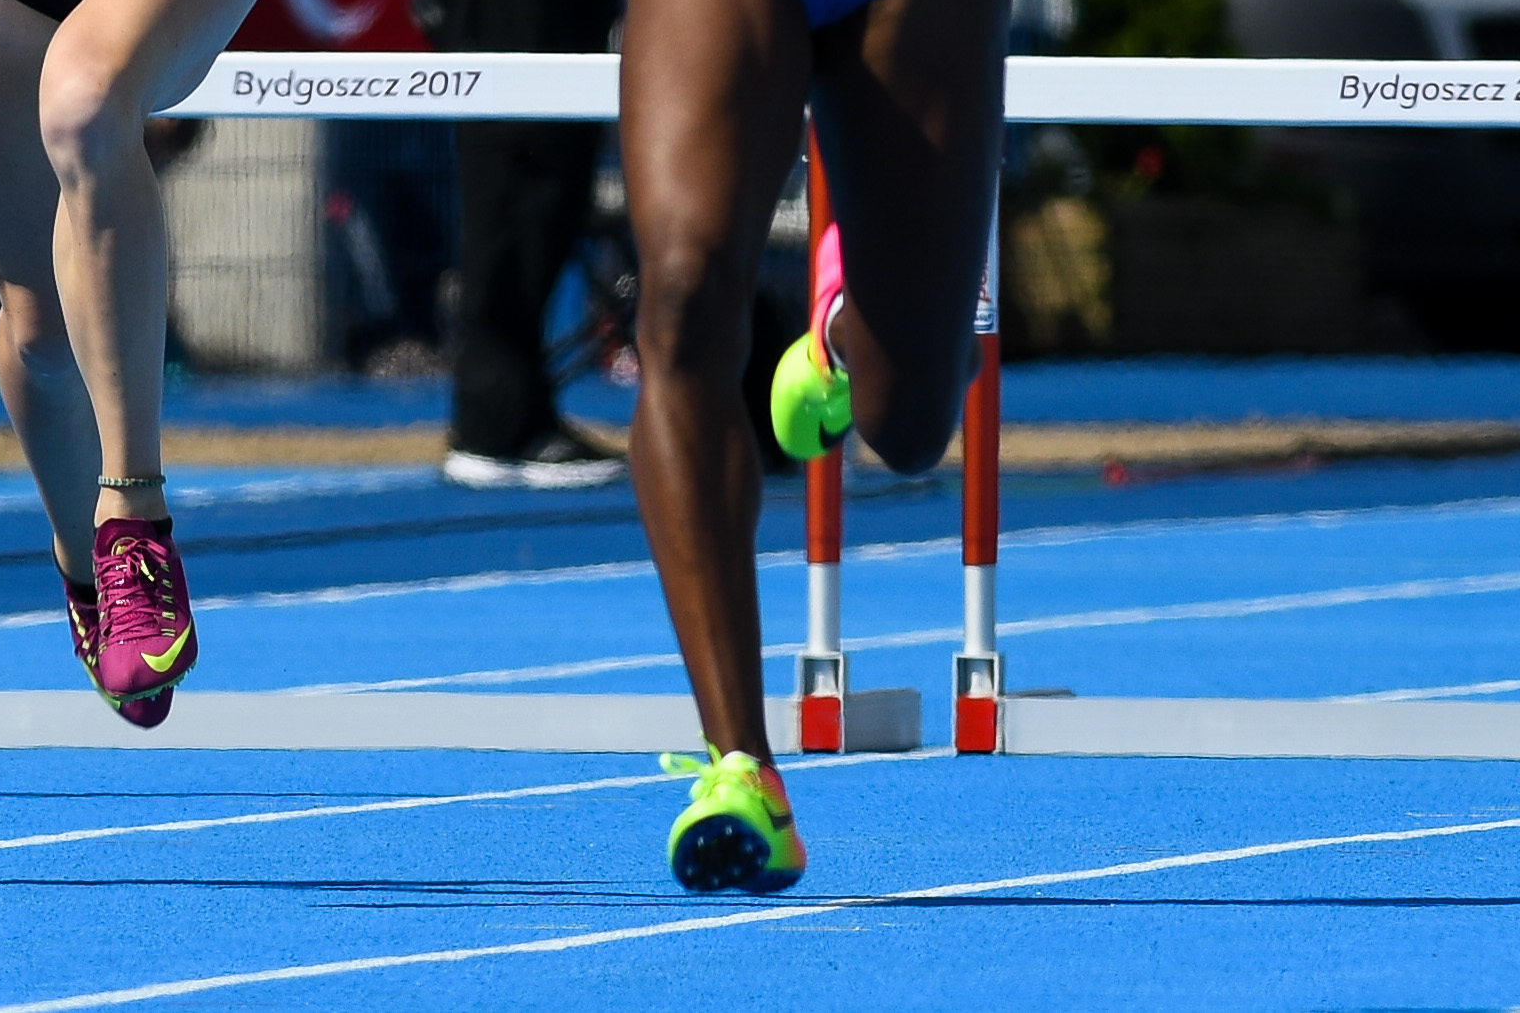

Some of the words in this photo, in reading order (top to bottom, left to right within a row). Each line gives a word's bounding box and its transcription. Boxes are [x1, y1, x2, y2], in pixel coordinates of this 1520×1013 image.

[233, 69, 402, 105] Bydgoszcz
[408, 70, 482, 97] 2017
[1340, 73, 1506, 109] Bydgoszcz
